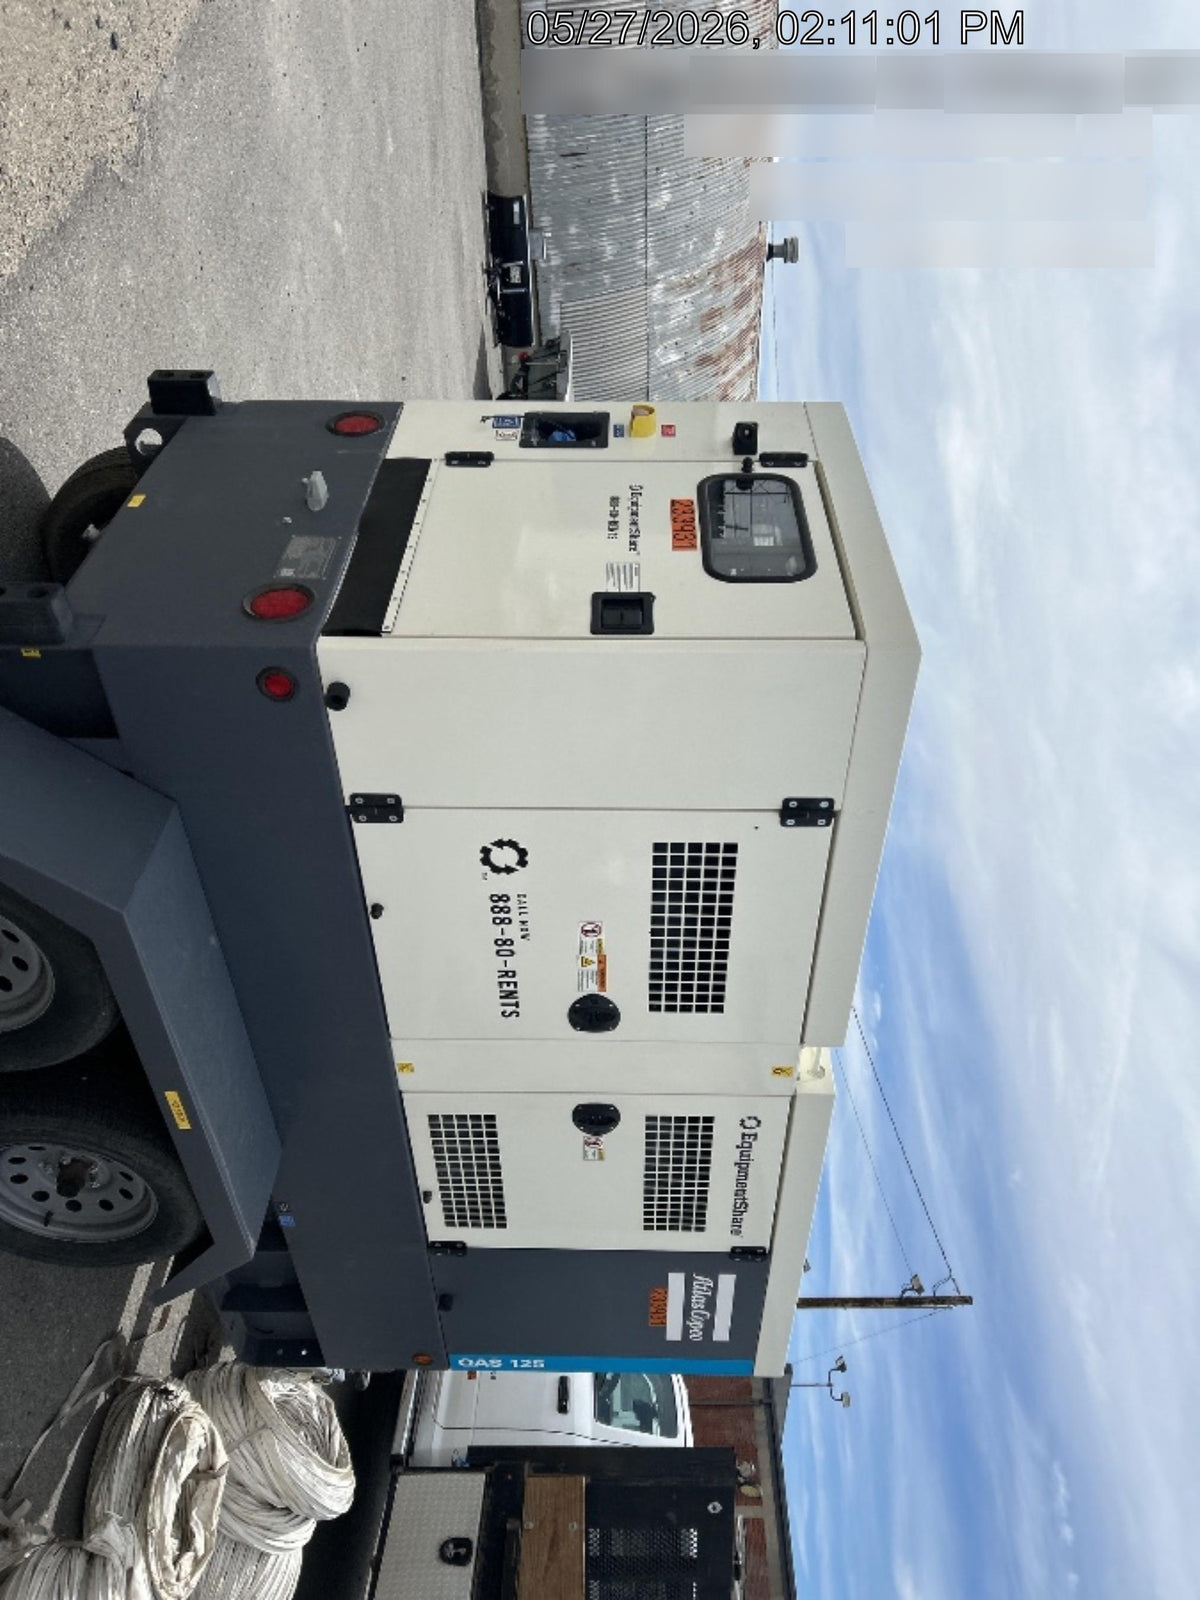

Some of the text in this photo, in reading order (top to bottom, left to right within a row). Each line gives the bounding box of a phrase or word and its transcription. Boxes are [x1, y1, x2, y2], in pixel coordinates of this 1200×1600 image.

[489, 893, 520, 1018] 888-80-RENTS
[730, 1132, 757, 1236] EquipmentShare
[510, 1359, 545, 1368] 125
